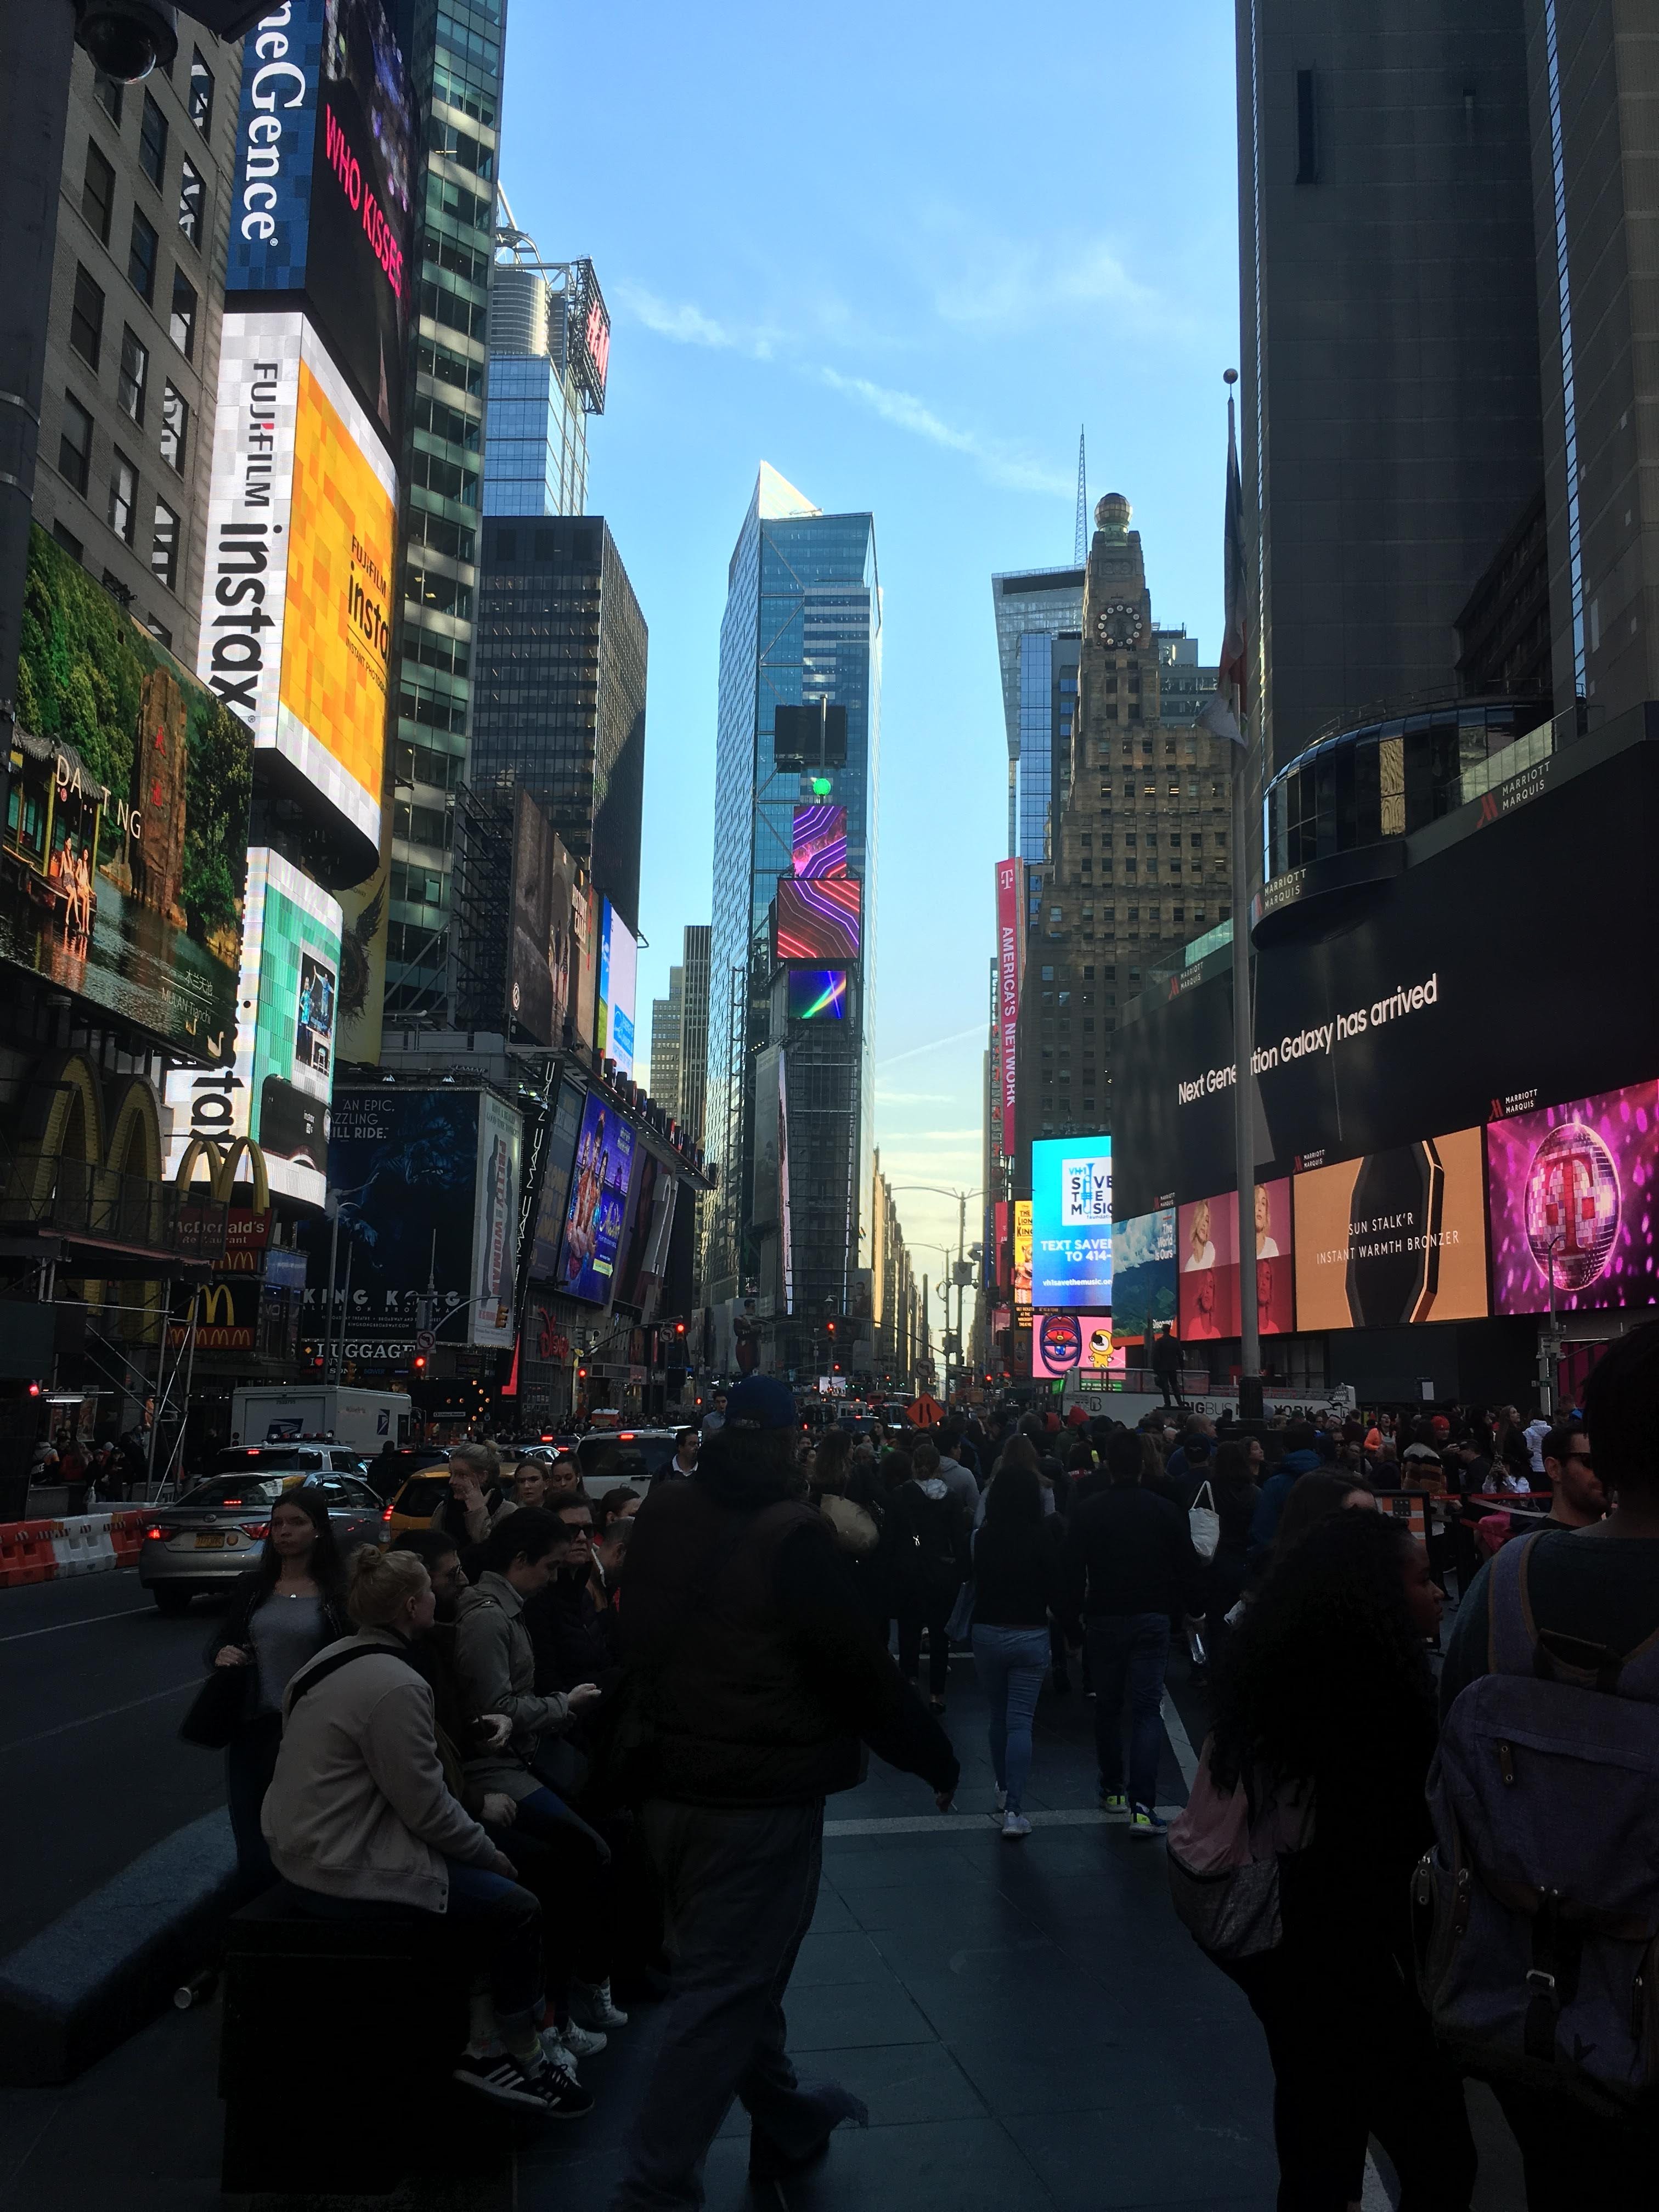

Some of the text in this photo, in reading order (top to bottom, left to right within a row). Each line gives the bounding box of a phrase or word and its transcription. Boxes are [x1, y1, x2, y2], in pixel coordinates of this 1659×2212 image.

[325, 102, 403, 298] WHO KISSES
[244, 362, 278, 508] FUJIFILM
[351, 534, 386, 598] FUJIFILM
[210, 523, 283, 712] instax
[348, 560, 391, 668] insta
[346, 636, 365, 669] INSTANT
[1503, 761, 1550, 794] MARRIOTT
[1503, 781, 1545, 810] MARQUIS
[1265, 868, 1307, 897] MARRIOTT
[1265, 884, 1301, 910] MARQUIS
[1180, 961, 1204, 980] MARRIOTT
[1180, 973, 1201, 990] MARQUIS
[162, 988, 211, 1025] MULAN Tianchi
[1002, 927, 1017, 1108] AMERICA'S NETWORK
[1178, 972, 1438, 1105] Next Genetion Galaxy has arrived
[1505, 1089, 1538, 1105] MARRIOTT
[1505, 1099, 1535, 1114] MARQUIS
[527, 1128, 544, 1189] MAC
[1304, 1149, 1325, 1160] MARRIOTT
[1304, 1158, 1323, 1168] MARQUIS
[1018, 1216, 1032, 1226] LION
[1163, 1222, 1173, 1233] The
[1348, 1212, 1414, 1236] SUN STALK'R
[1040, 1240, 1071, 1251] TEXT
[1158, 1234, 1173, 1248] World
[1317, 1230, 1460, 1265] INSTANT WARMTH BRONZER
[1065, 1251, 1082, 1262] TO
[1160, 1249, 1173, 1261] Ours
[303, 1289, 369, 1305] KING
